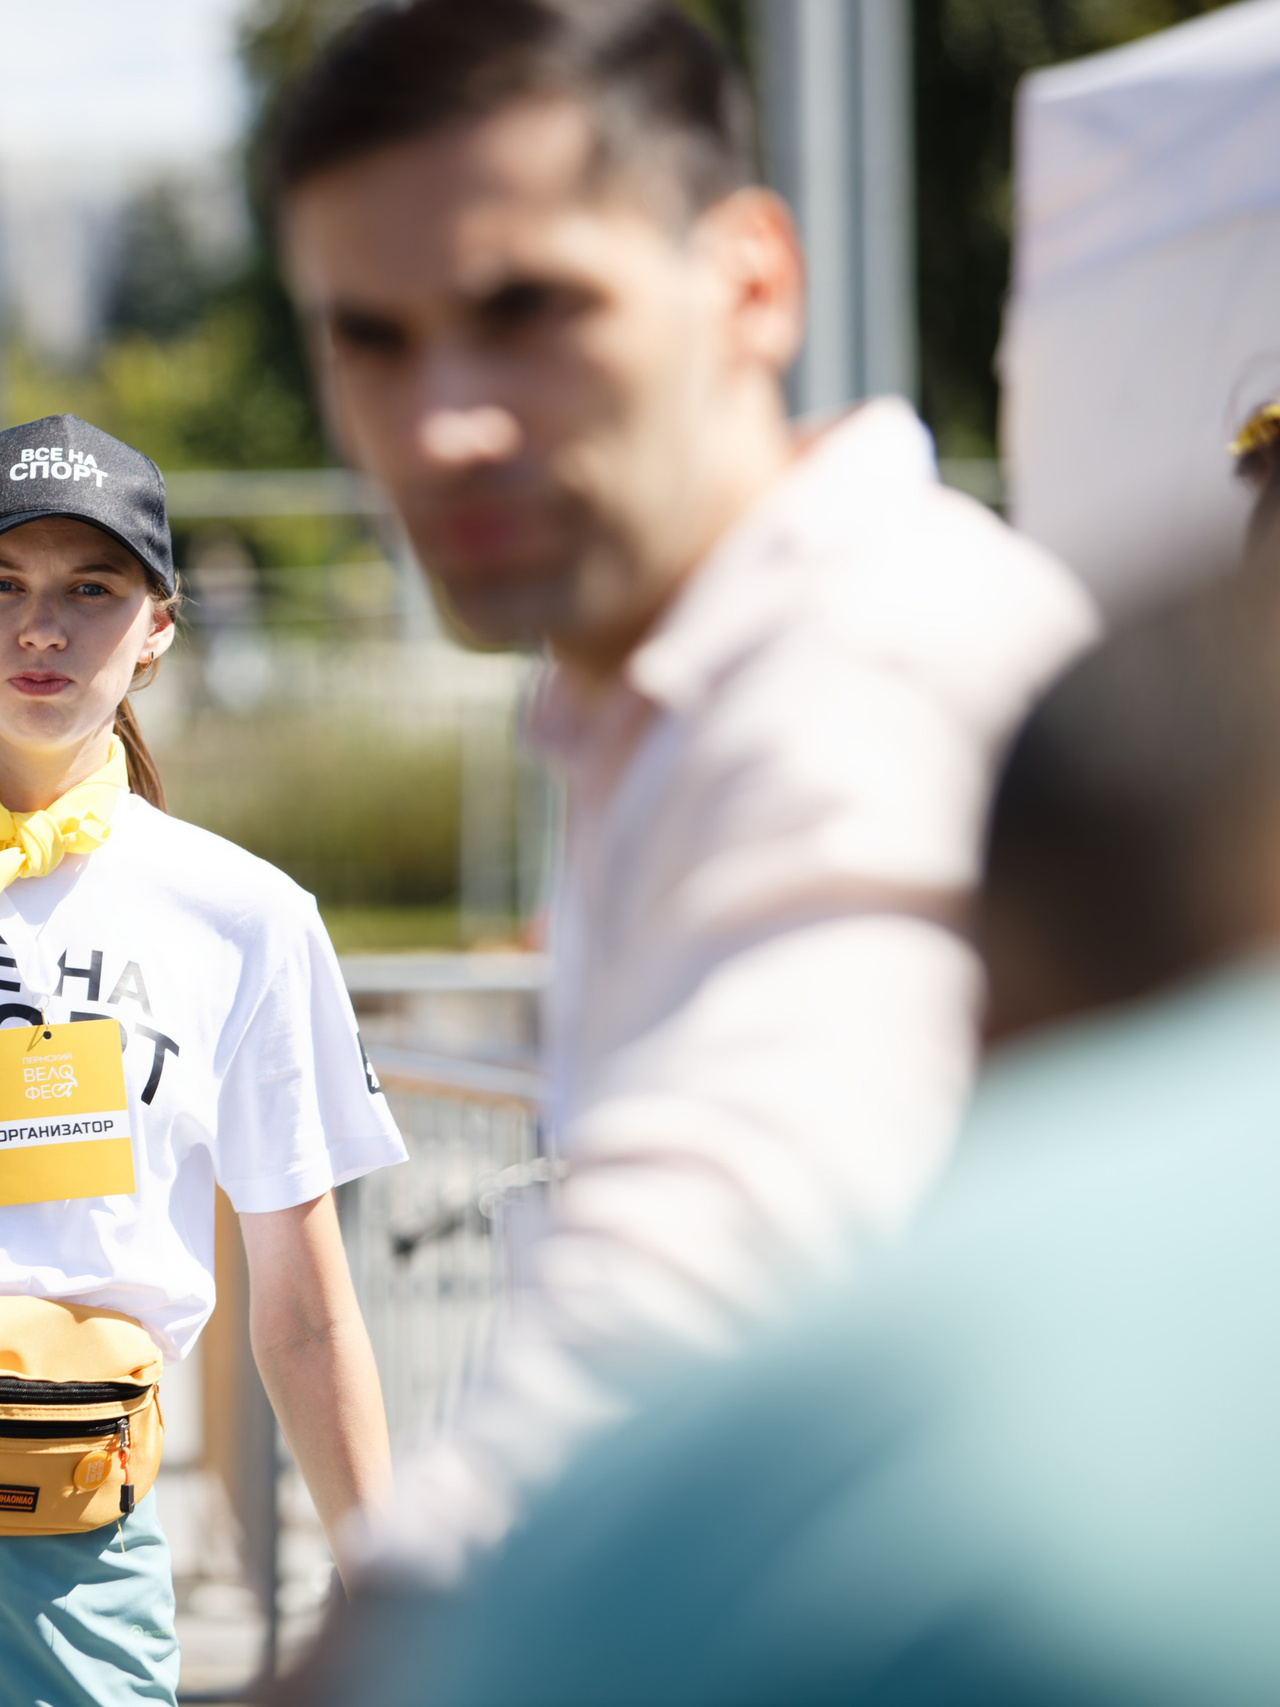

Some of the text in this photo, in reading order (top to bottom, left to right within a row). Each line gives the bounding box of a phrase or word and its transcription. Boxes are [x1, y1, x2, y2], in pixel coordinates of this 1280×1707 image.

[21, 447, 98, 468] ВСЕ НА
[9, 461, 108, 488] СПОРТ
[53, 948, 154, 1017] НА
[22, 1051, 73, 1065] ПЕРМСКИЙ
